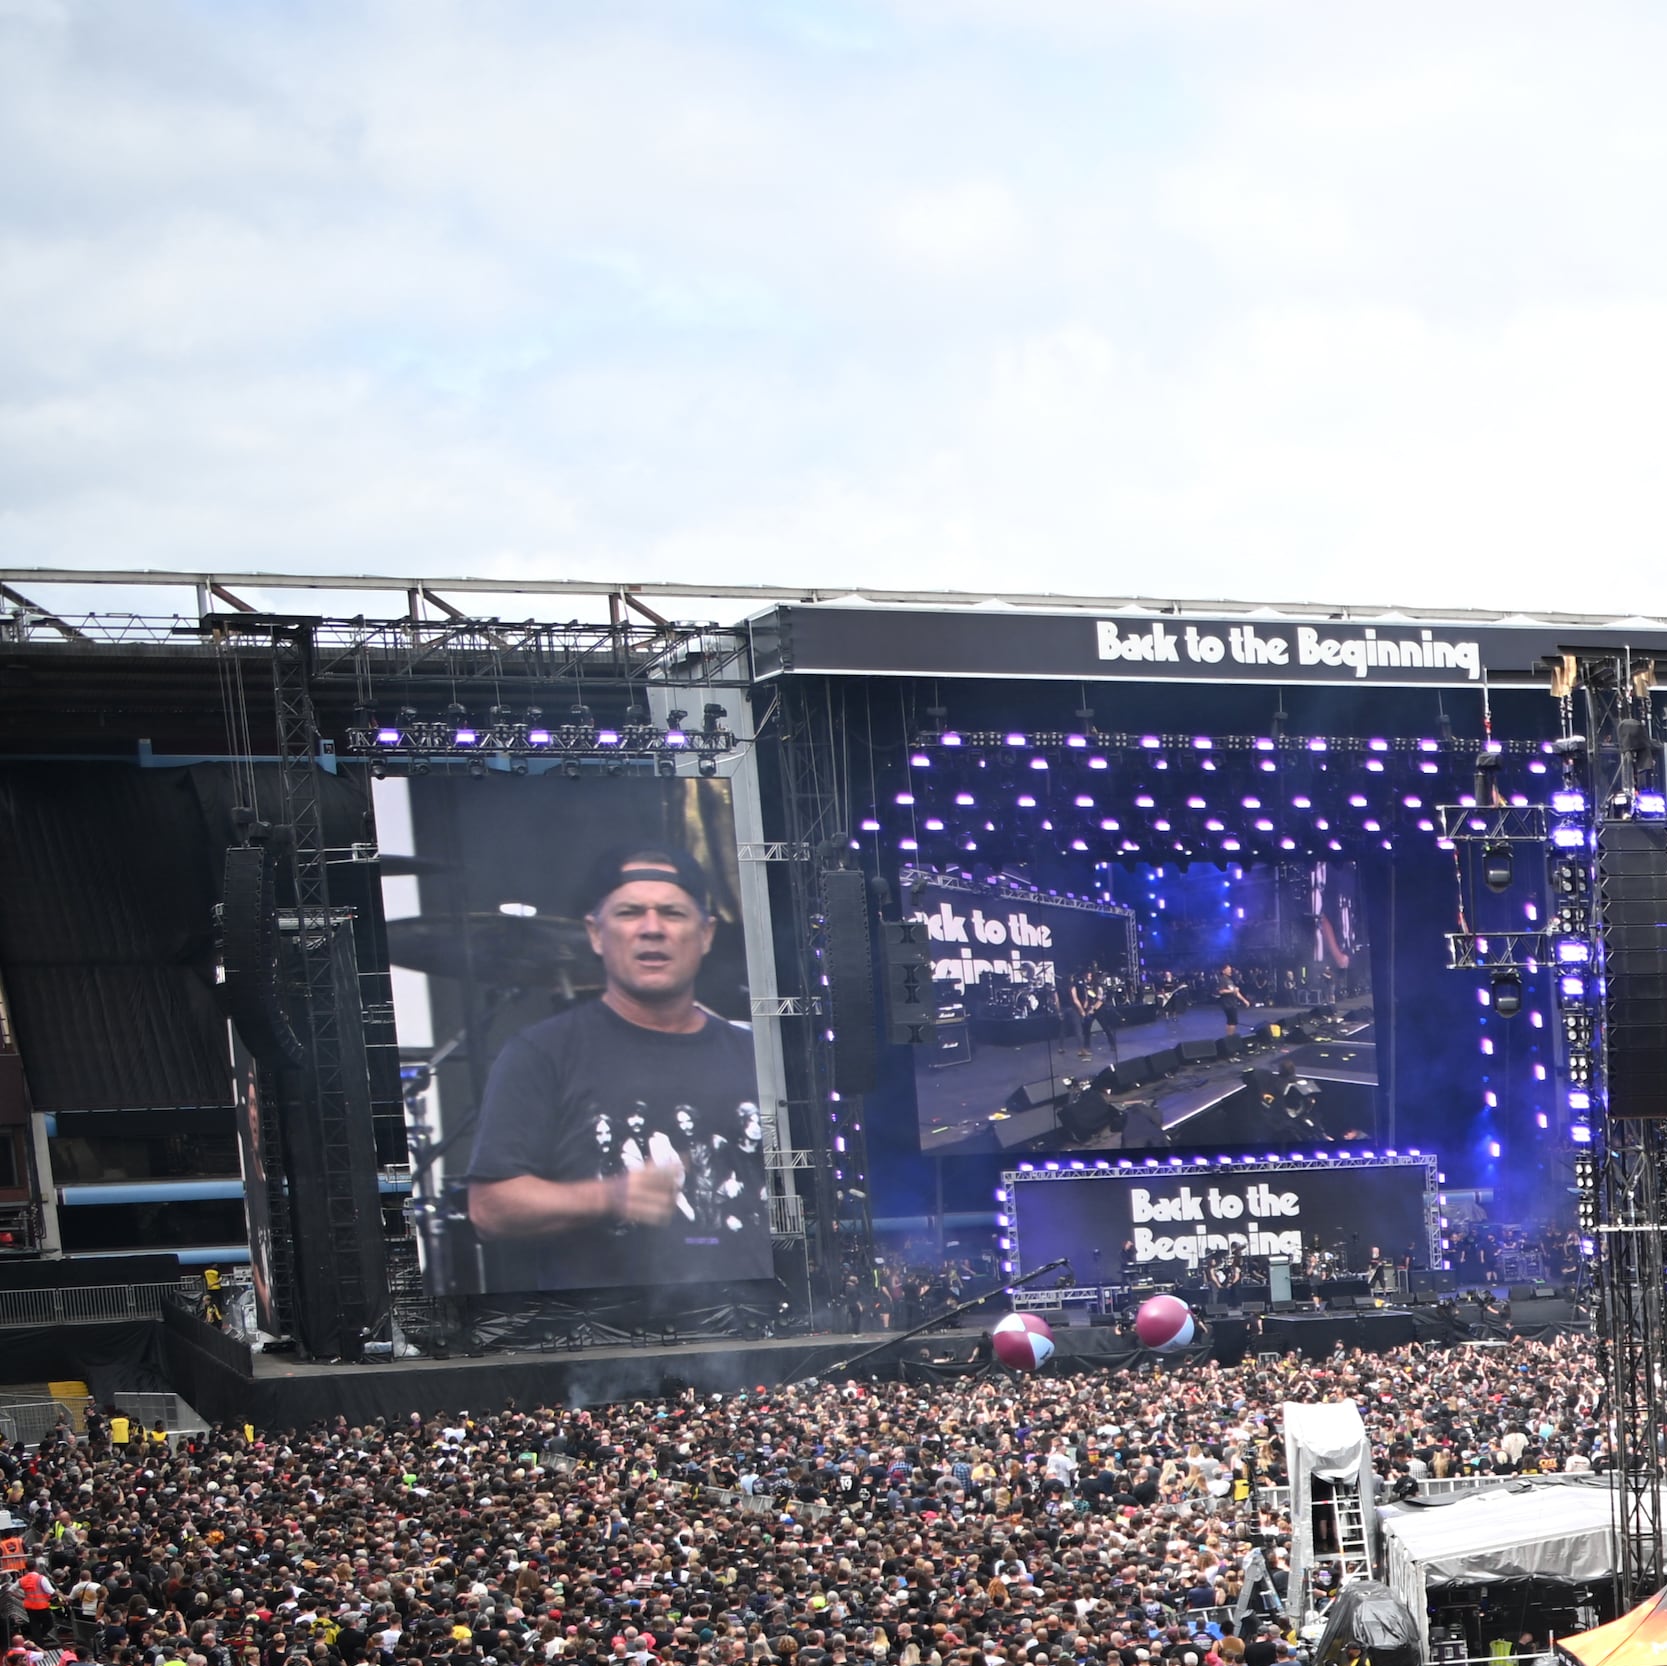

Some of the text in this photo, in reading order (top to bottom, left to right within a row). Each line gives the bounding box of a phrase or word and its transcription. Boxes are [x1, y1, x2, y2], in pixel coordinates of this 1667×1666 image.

[1096, 621, 1479, 680] Back to the Beginning
[972, 909, 1053, 947] to the
[1131, 1183, 1300, 1223] Back to the
[1134, 1221, 1302, 1270] Beginning
